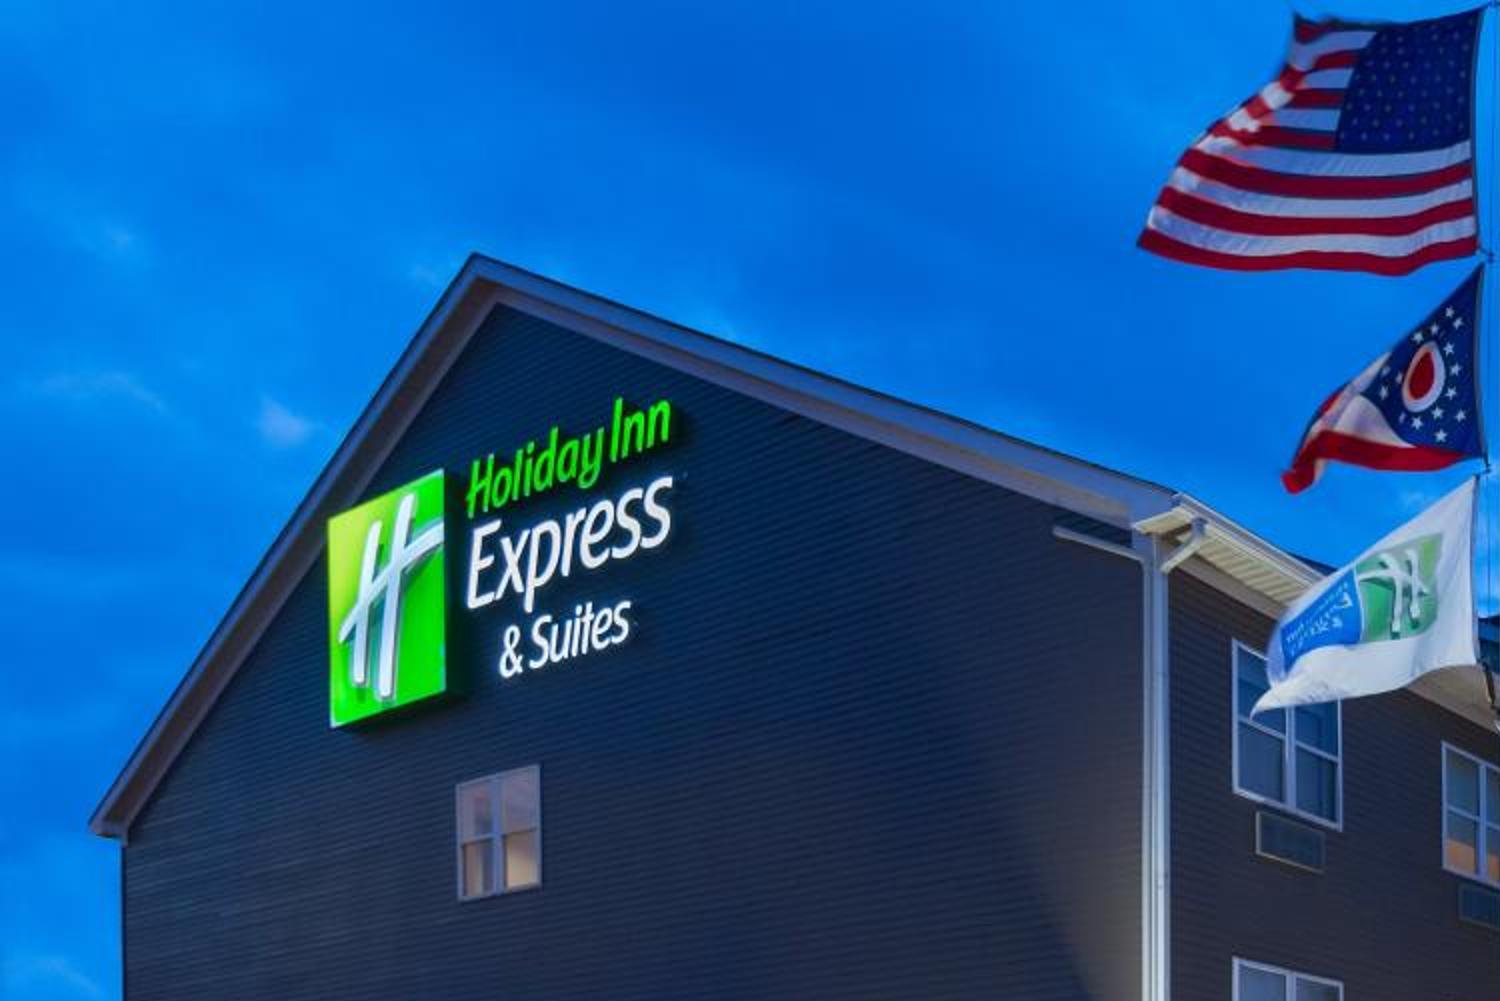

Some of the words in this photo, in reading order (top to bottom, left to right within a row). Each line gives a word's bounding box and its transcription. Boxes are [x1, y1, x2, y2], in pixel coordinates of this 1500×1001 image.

[467, 427, 605, 518] Holiday
[609, 397, 671, 462] Inn
[338, 493, 445, 699] H
[466, 476, 674, 613] Express
[499, 625, 524, 679] &
[529, 601, 631, 670] Suites
